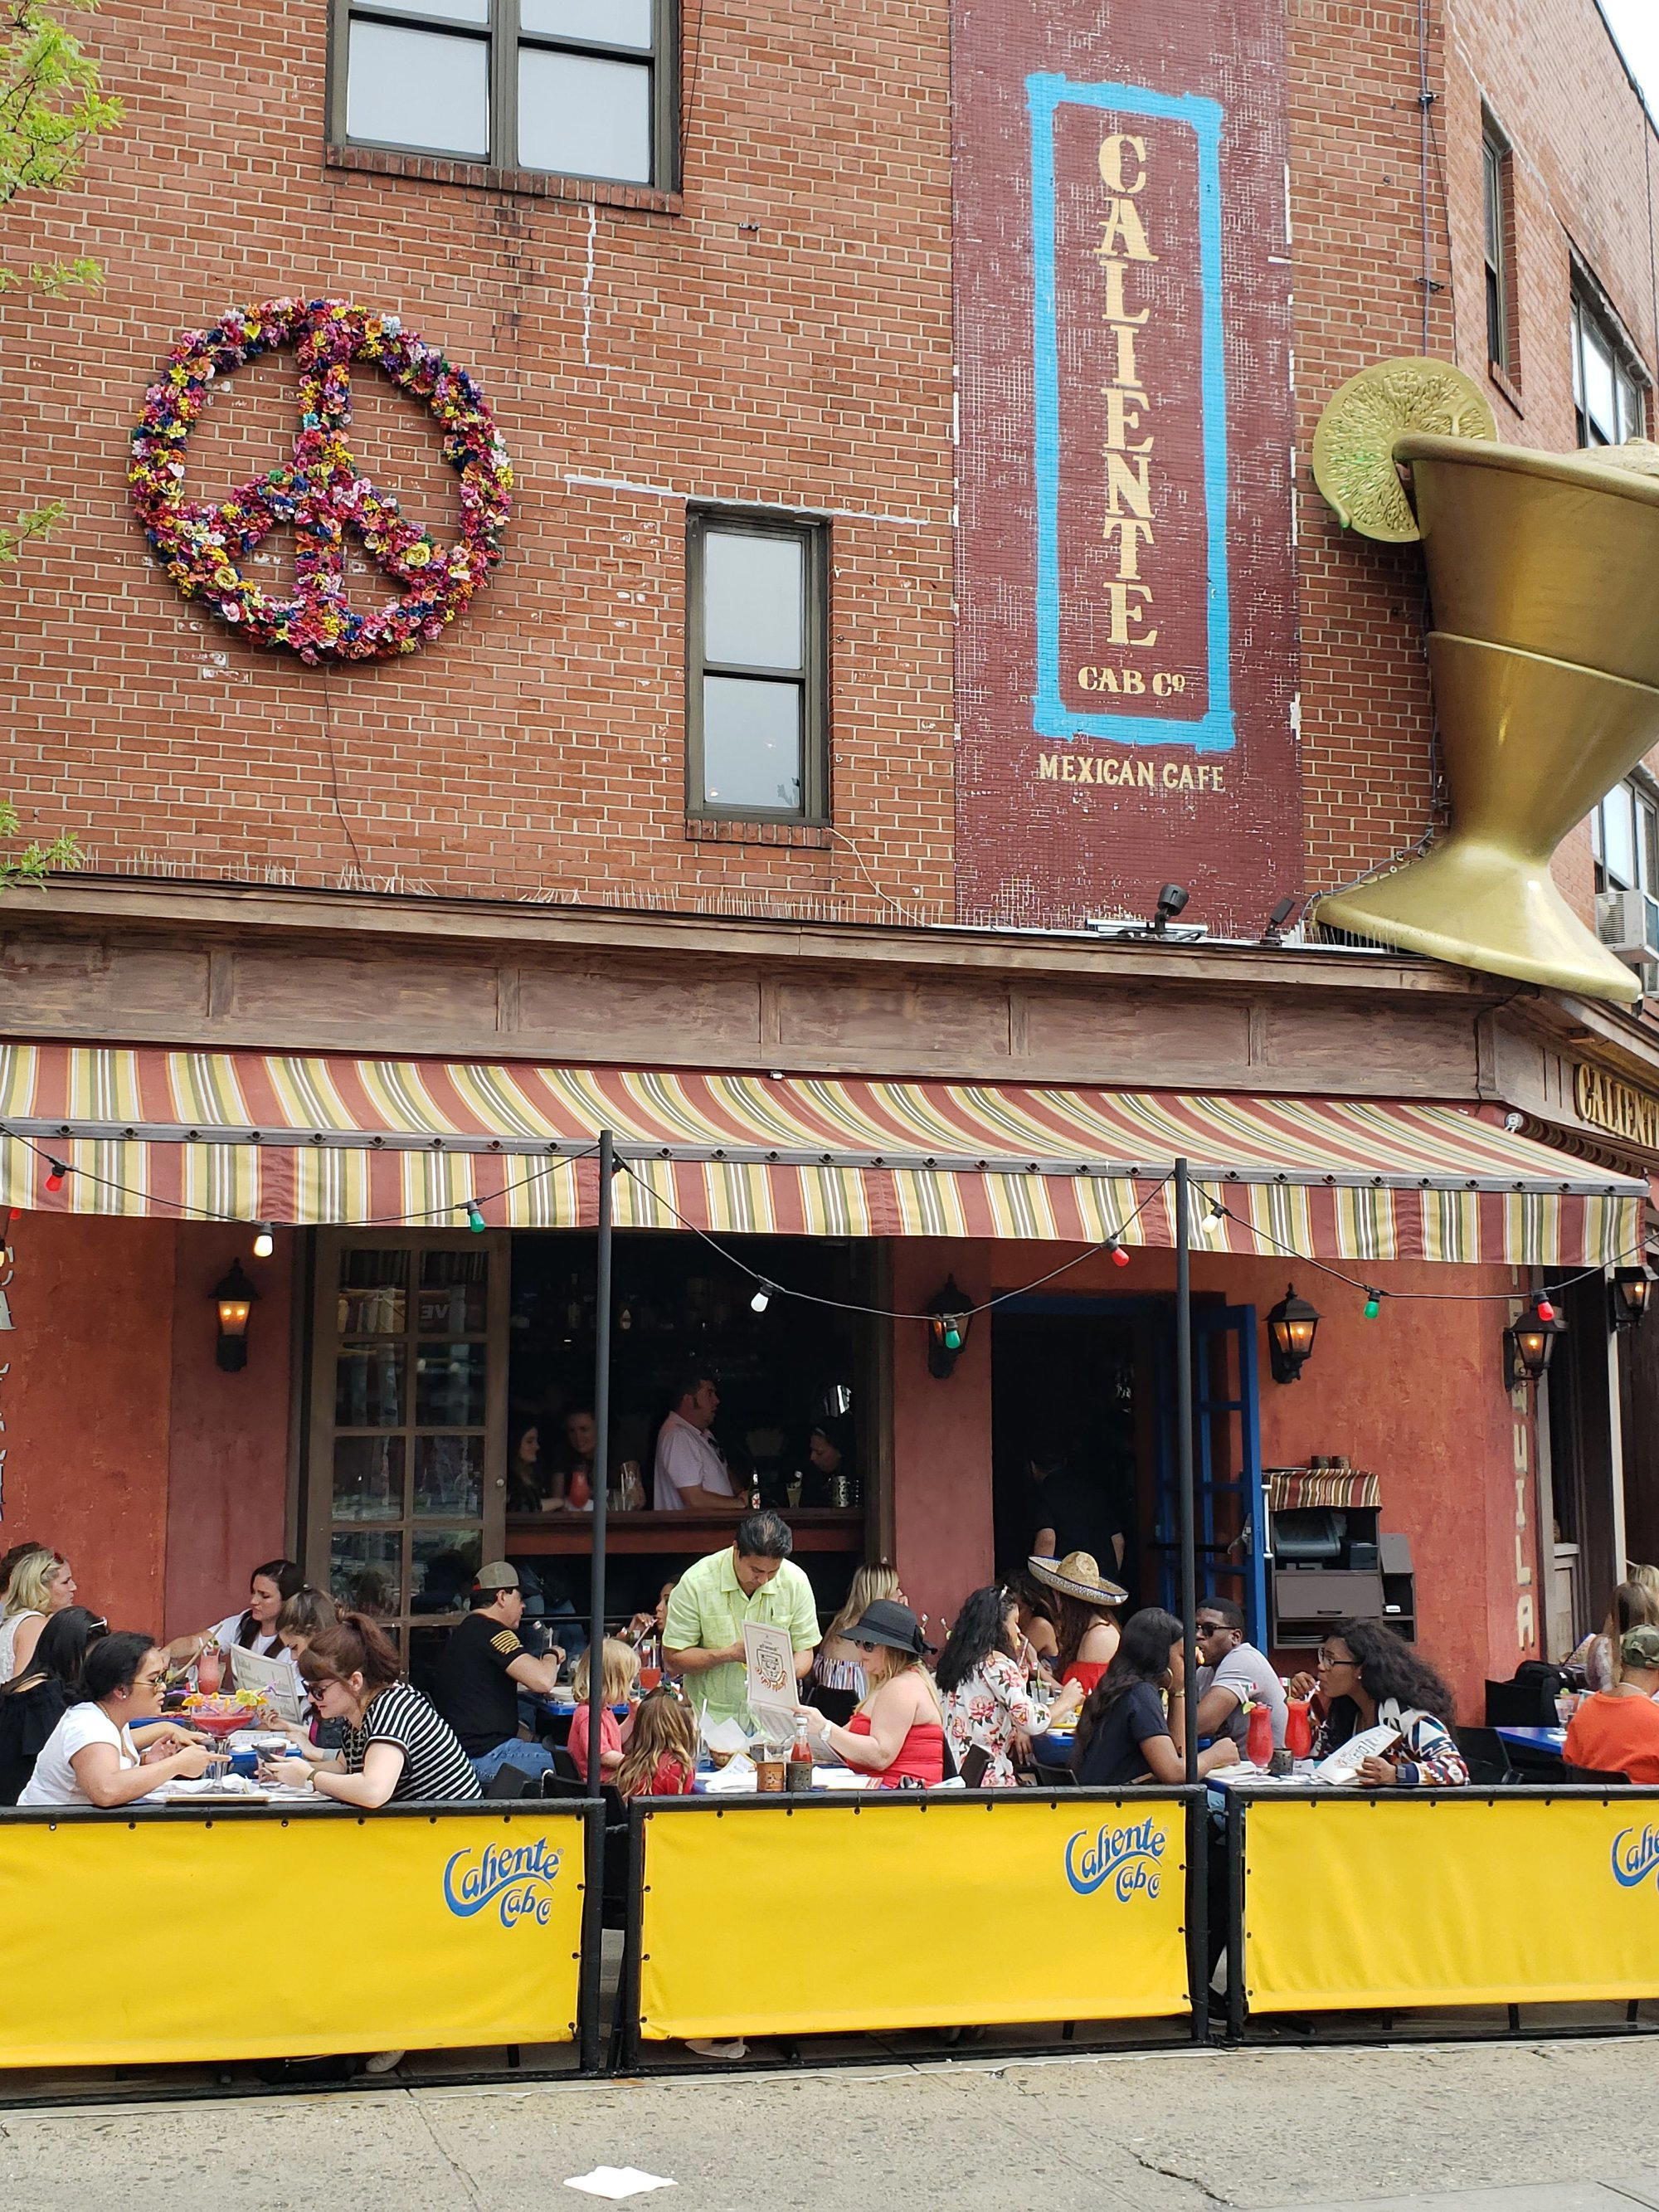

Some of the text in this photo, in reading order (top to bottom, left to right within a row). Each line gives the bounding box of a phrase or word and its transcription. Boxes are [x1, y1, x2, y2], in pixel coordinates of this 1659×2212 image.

[1093, 134, 1160, 646] CALIENTE
[1078, 665, 1146, 695] CAB
[1039, 753, 1226, 792] MEXICAN CAFE
[444, 1836, 560, 1917] Caliente
[1065, 1816, 1166, 1895] Caliente
[1116, 1861, 1146, 1903] Cab
[1611, 1823, 1659, 1888] Cali
[500, 1883, 537, 1928] Cab
